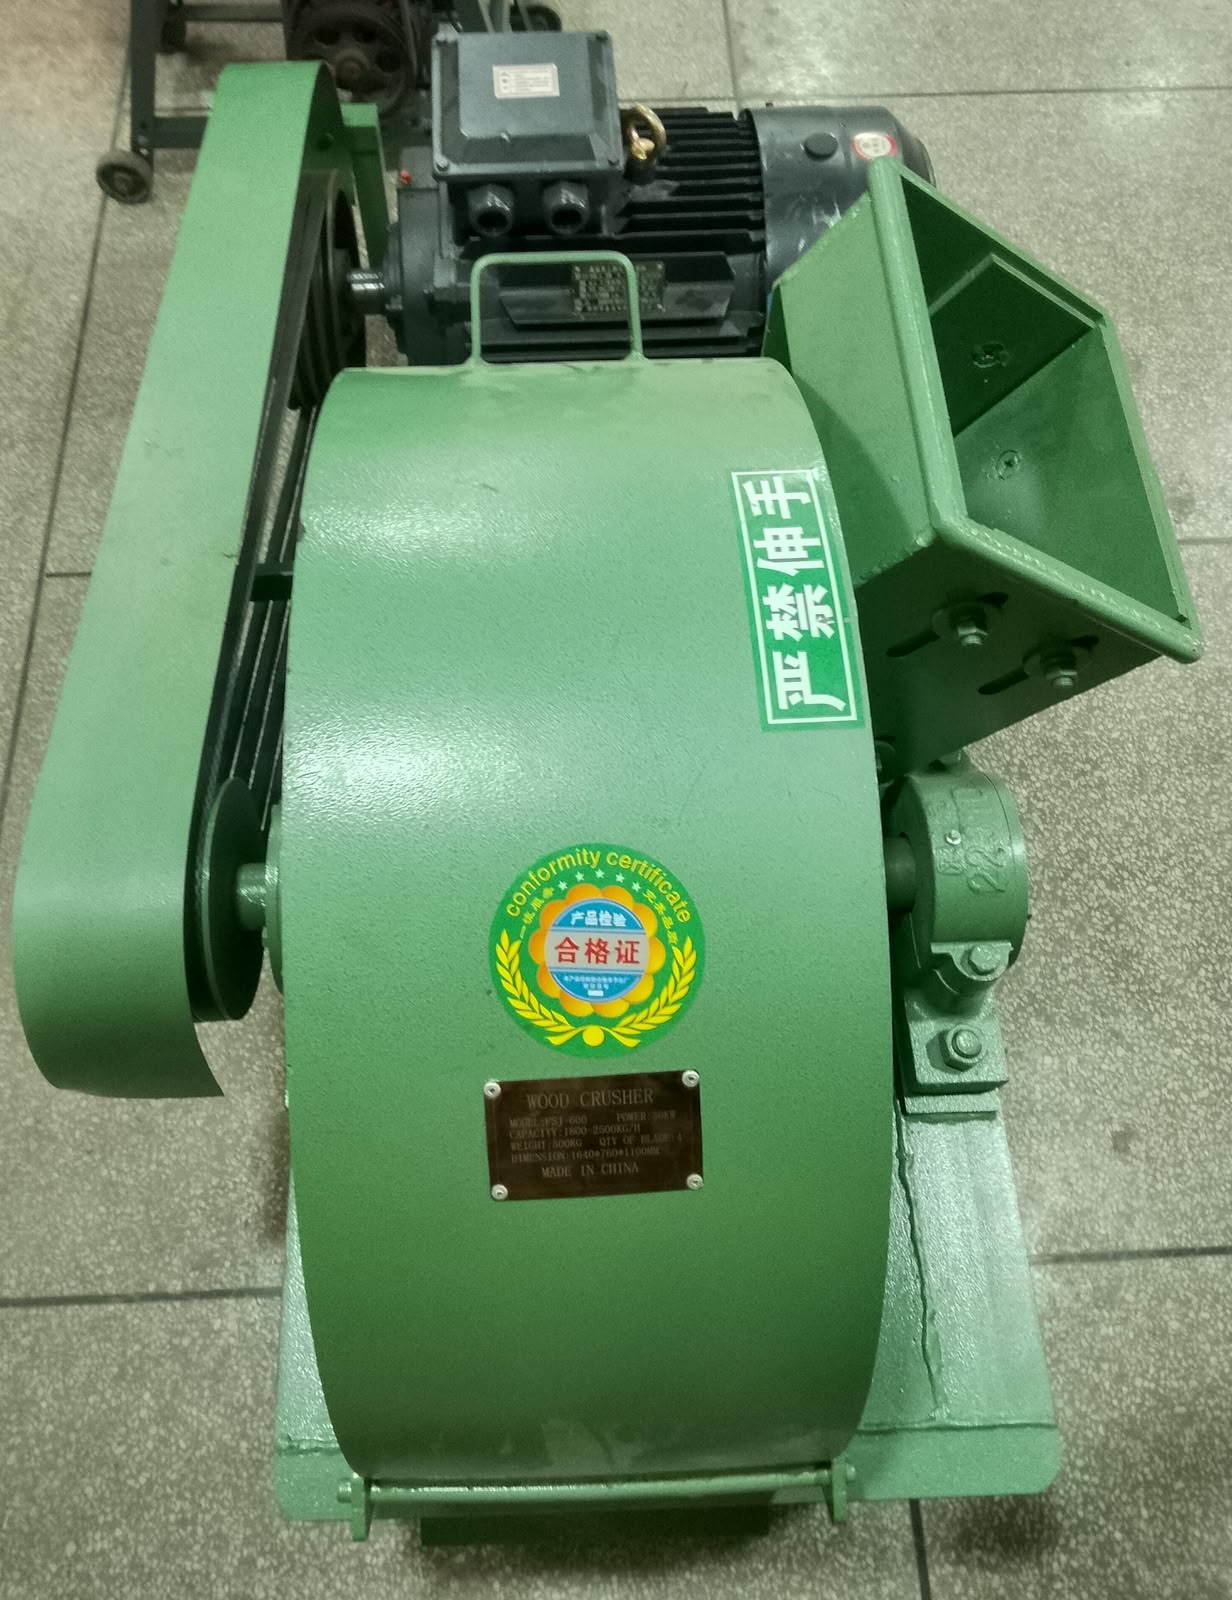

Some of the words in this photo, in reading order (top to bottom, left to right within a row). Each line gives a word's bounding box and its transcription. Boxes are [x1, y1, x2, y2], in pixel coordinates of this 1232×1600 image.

[743, 476, 846, 712] 严禁伸手
[506, 848, 600, 917] conformity
[606, 850, 691, 923] certificate
[570, 910, 627, 927] 产品检验
[555, 937, 641, 964] 合格证
[526, 1092, 570, 1110] WOOD
[580, 1088, 654, 1108] CRUSHER
[541, 1166, 572, 1178] MADE
[581, 1164, 594, 1177] IN
[601, 1161, 639, 1176] CHINA
